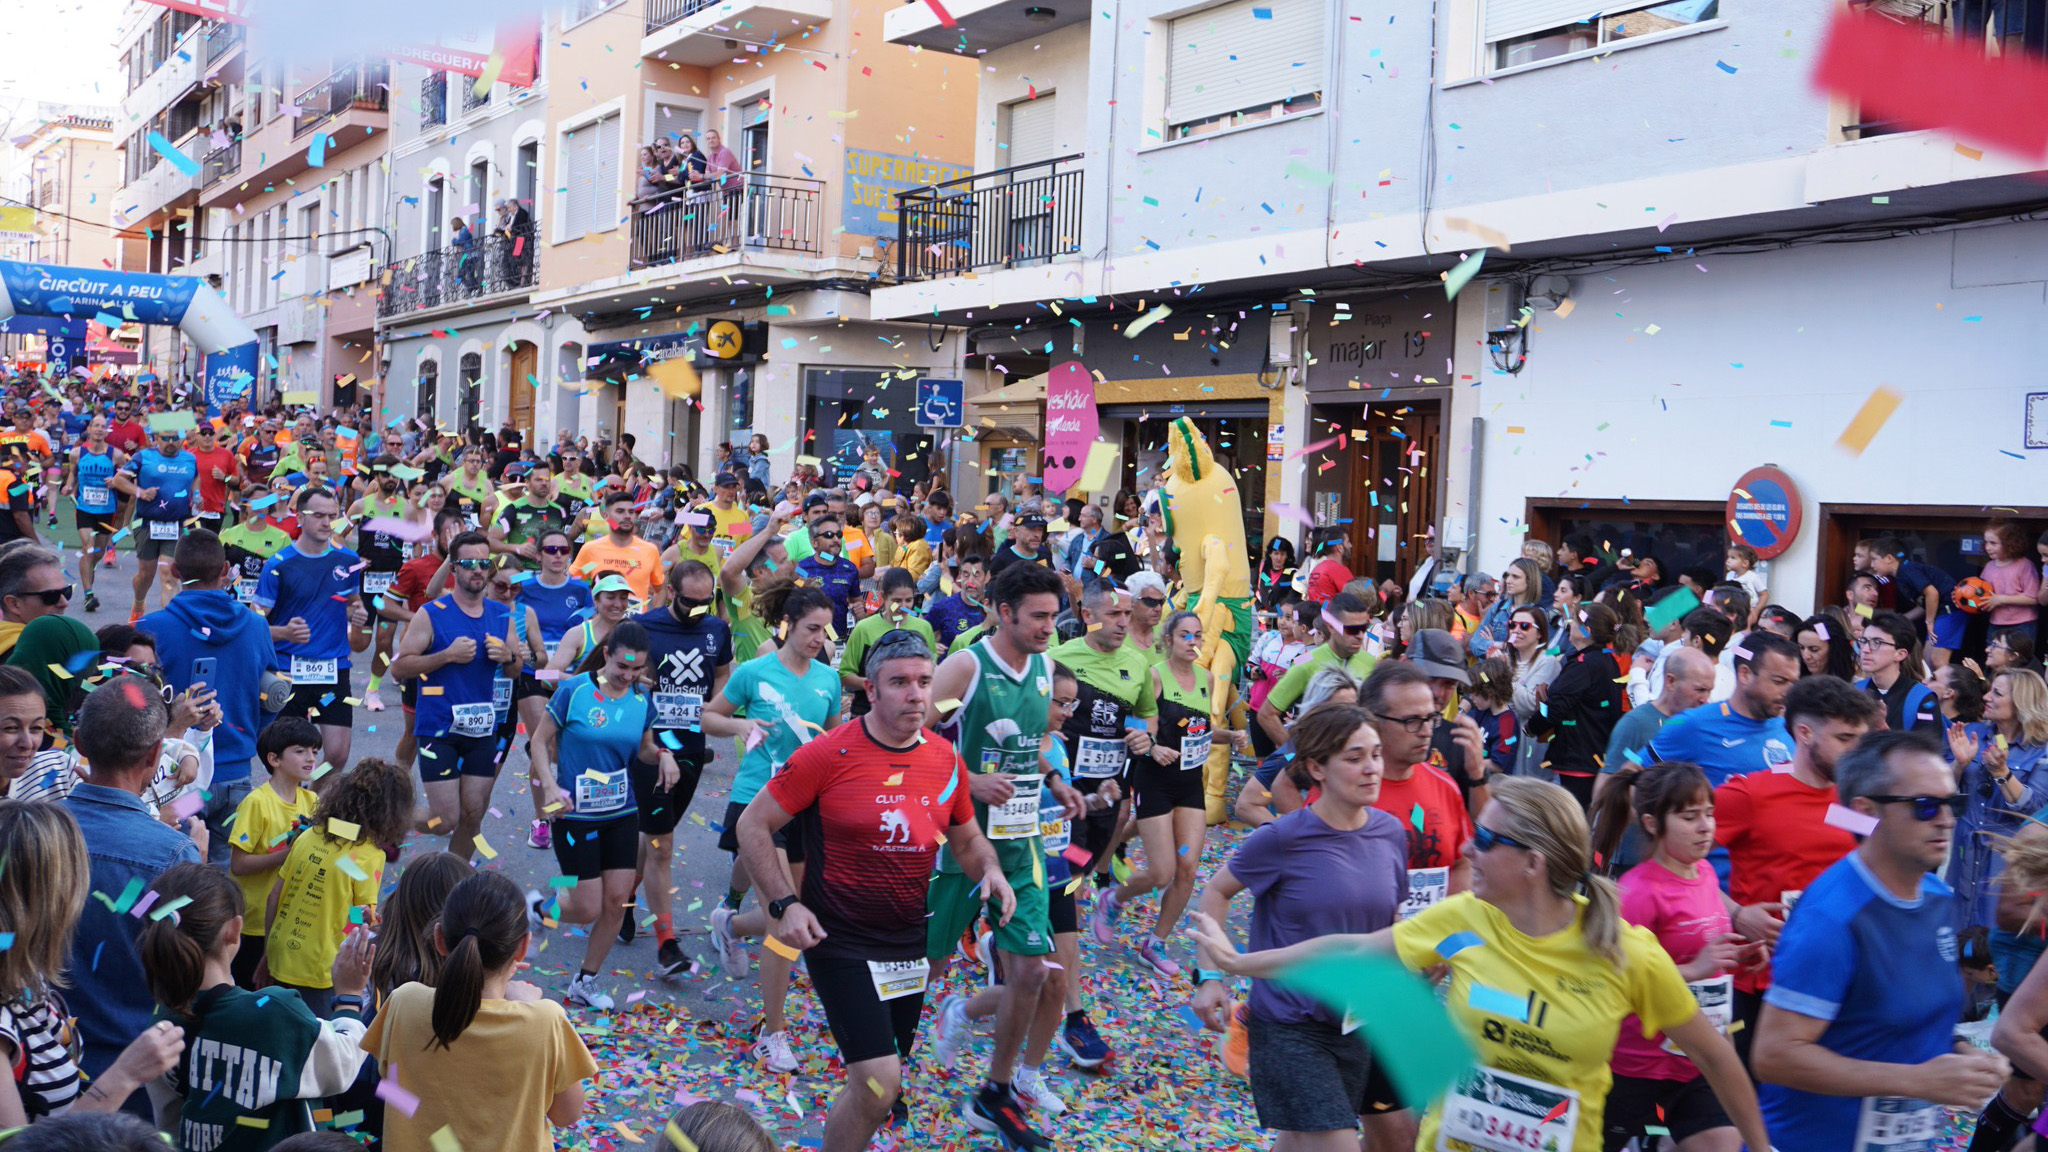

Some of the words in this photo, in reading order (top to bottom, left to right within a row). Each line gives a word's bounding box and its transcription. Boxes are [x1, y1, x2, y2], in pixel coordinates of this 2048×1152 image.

[39, 277, 108, 295] CIRCUIT
[110, 284, 123, 296] A
[127, 285, 162, 299] PEU
[69, 296, 105, 306] MARINA
[1365, 313, 1391, 327] Plaça
[1330, 334, 1386, 368] major
[1403, 330, 1425, 358] 19
[305, 664, 323, 672] 869
[659, 675, 669, 684] la
[660, 684, 708, 695] VilaSalut
[669, 707, 689, 716] 424
[468, 716, 483, 726] 890
[1095, 753, 1114, 763] 512
[594, 786, 615, 798] 294
[1407, 892, 1431, 906] 594
